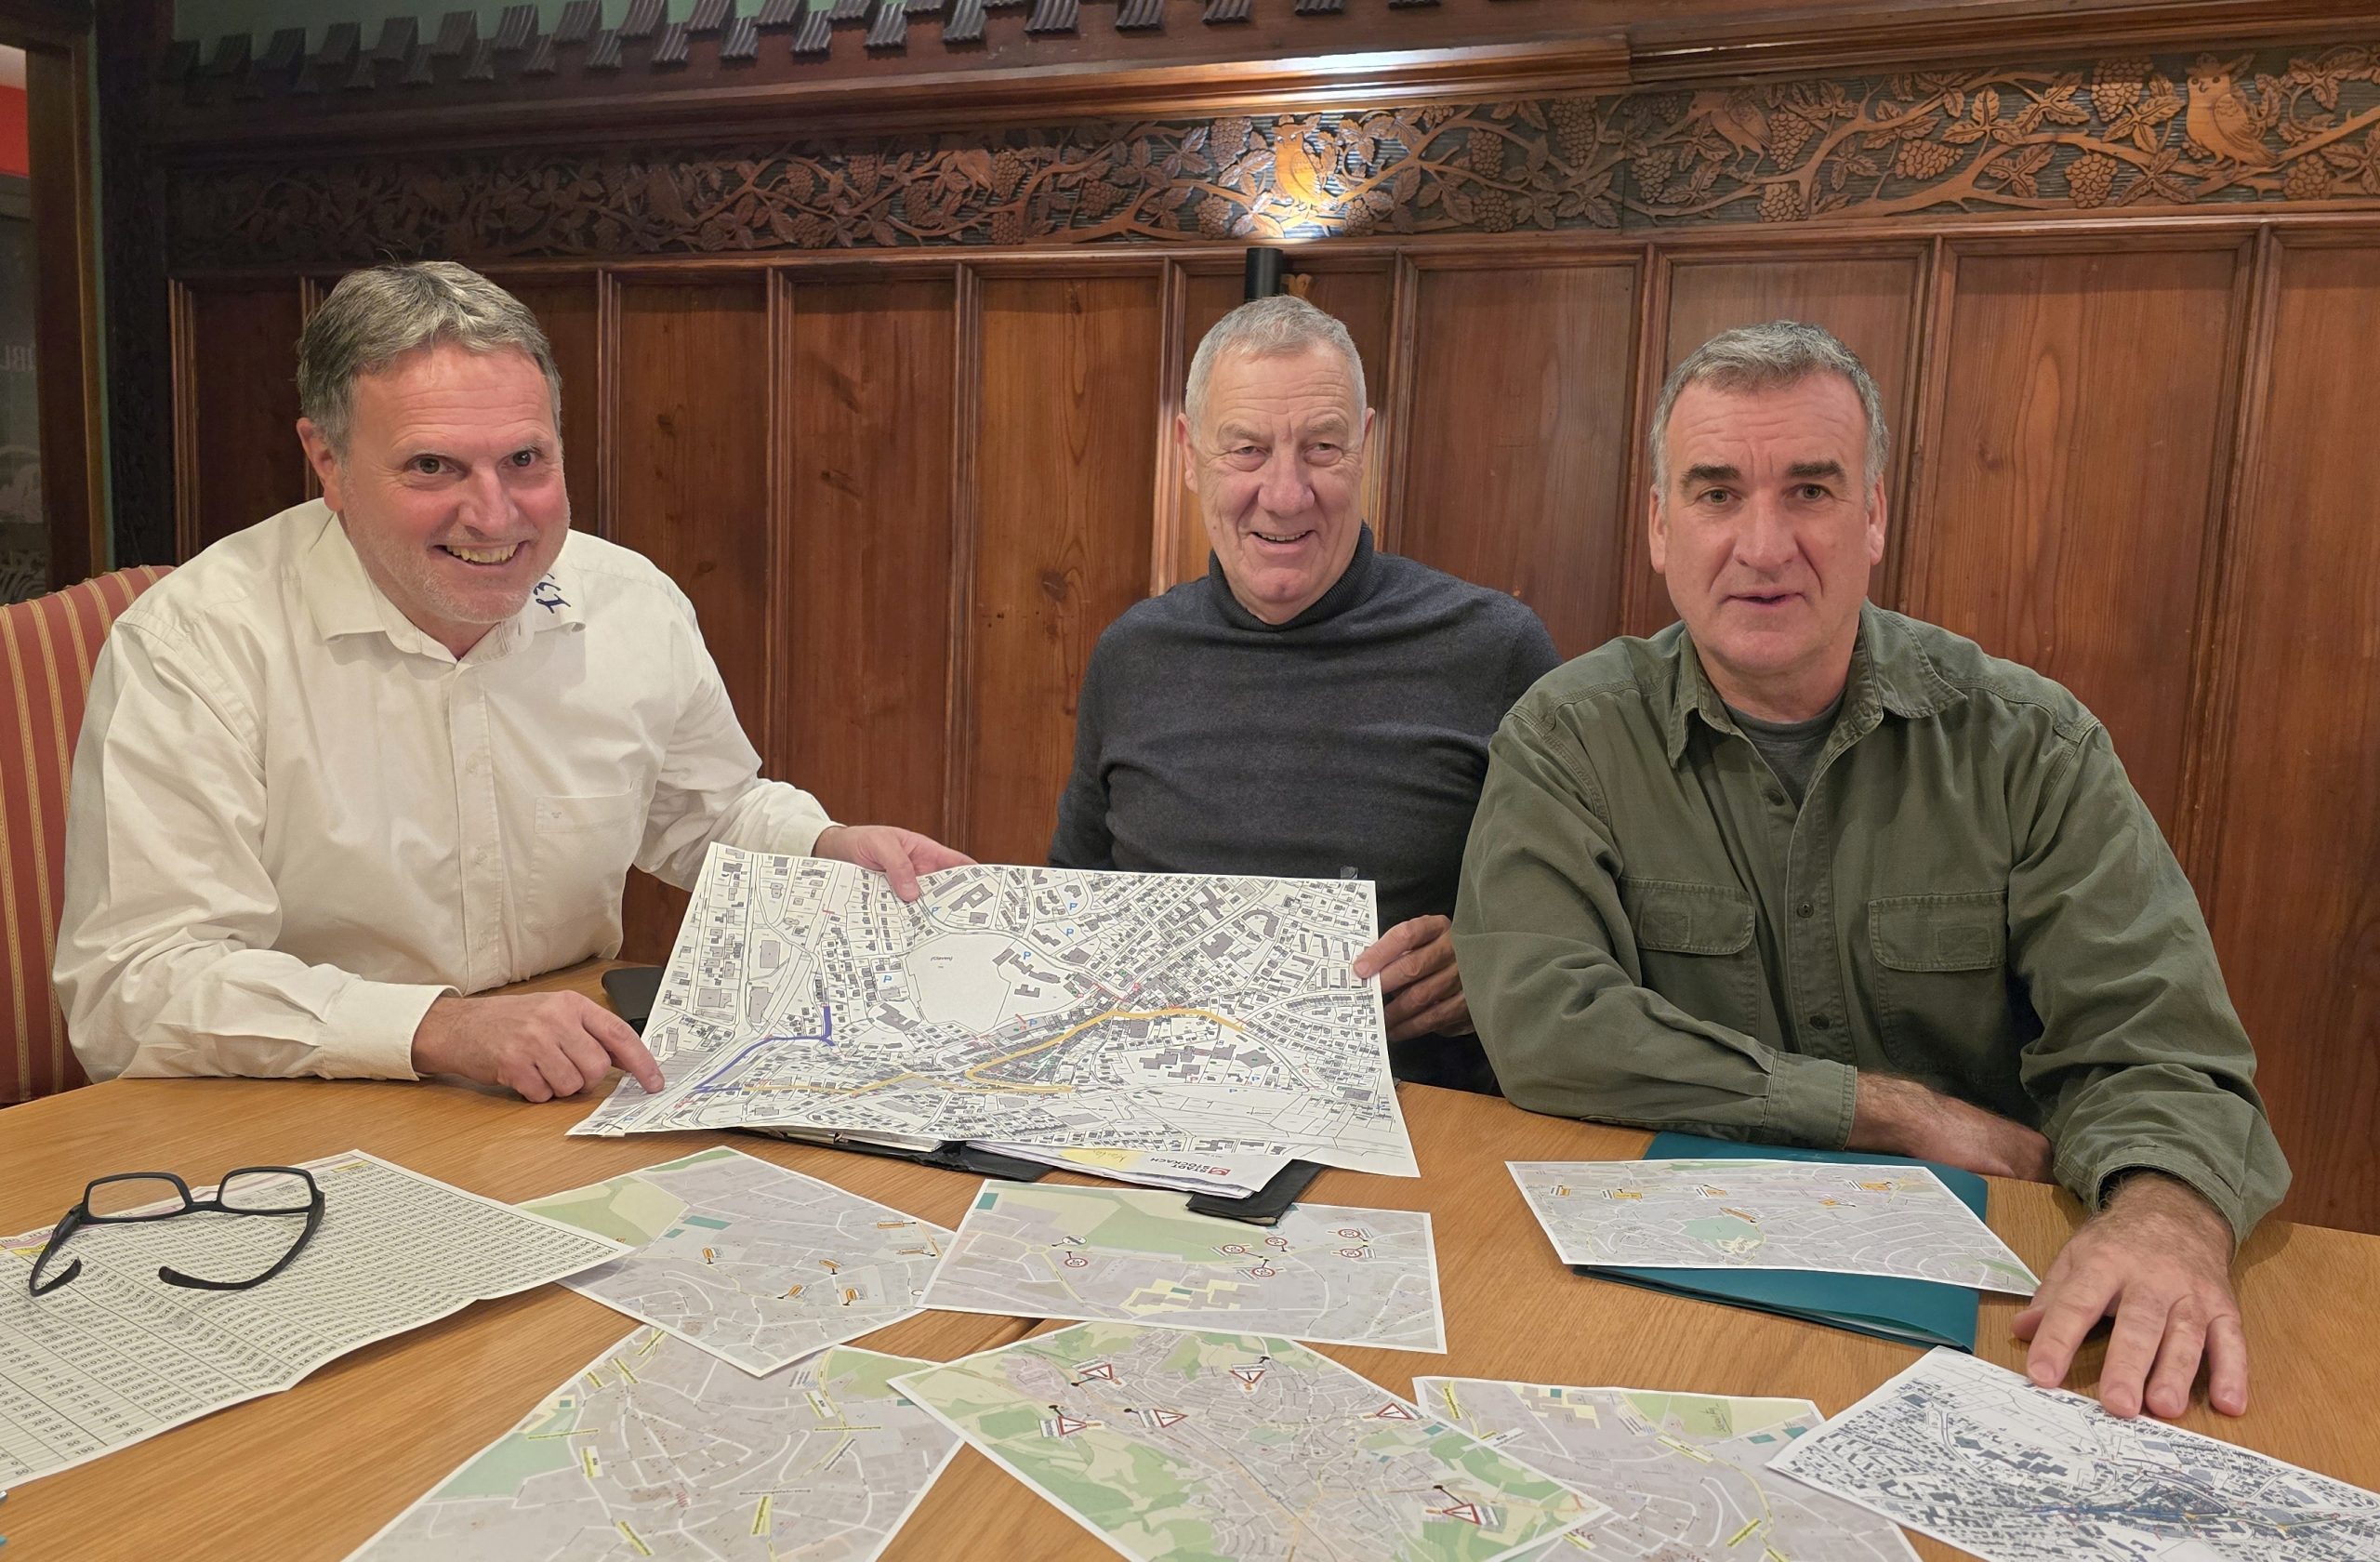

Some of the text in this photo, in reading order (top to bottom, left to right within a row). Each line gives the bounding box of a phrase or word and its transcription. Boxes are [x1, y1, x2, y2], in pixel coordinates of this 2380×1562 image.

[1024, 951, 1031, 960] P
[883, 974, 892, 983] P
[1150, 1158, 1210, 1169] STOCKACH
[1170, 1165, 1207, 1173] STADT
[101, 1413, 122, 1423] 240
[43, 1424, 63, 1433] 140
